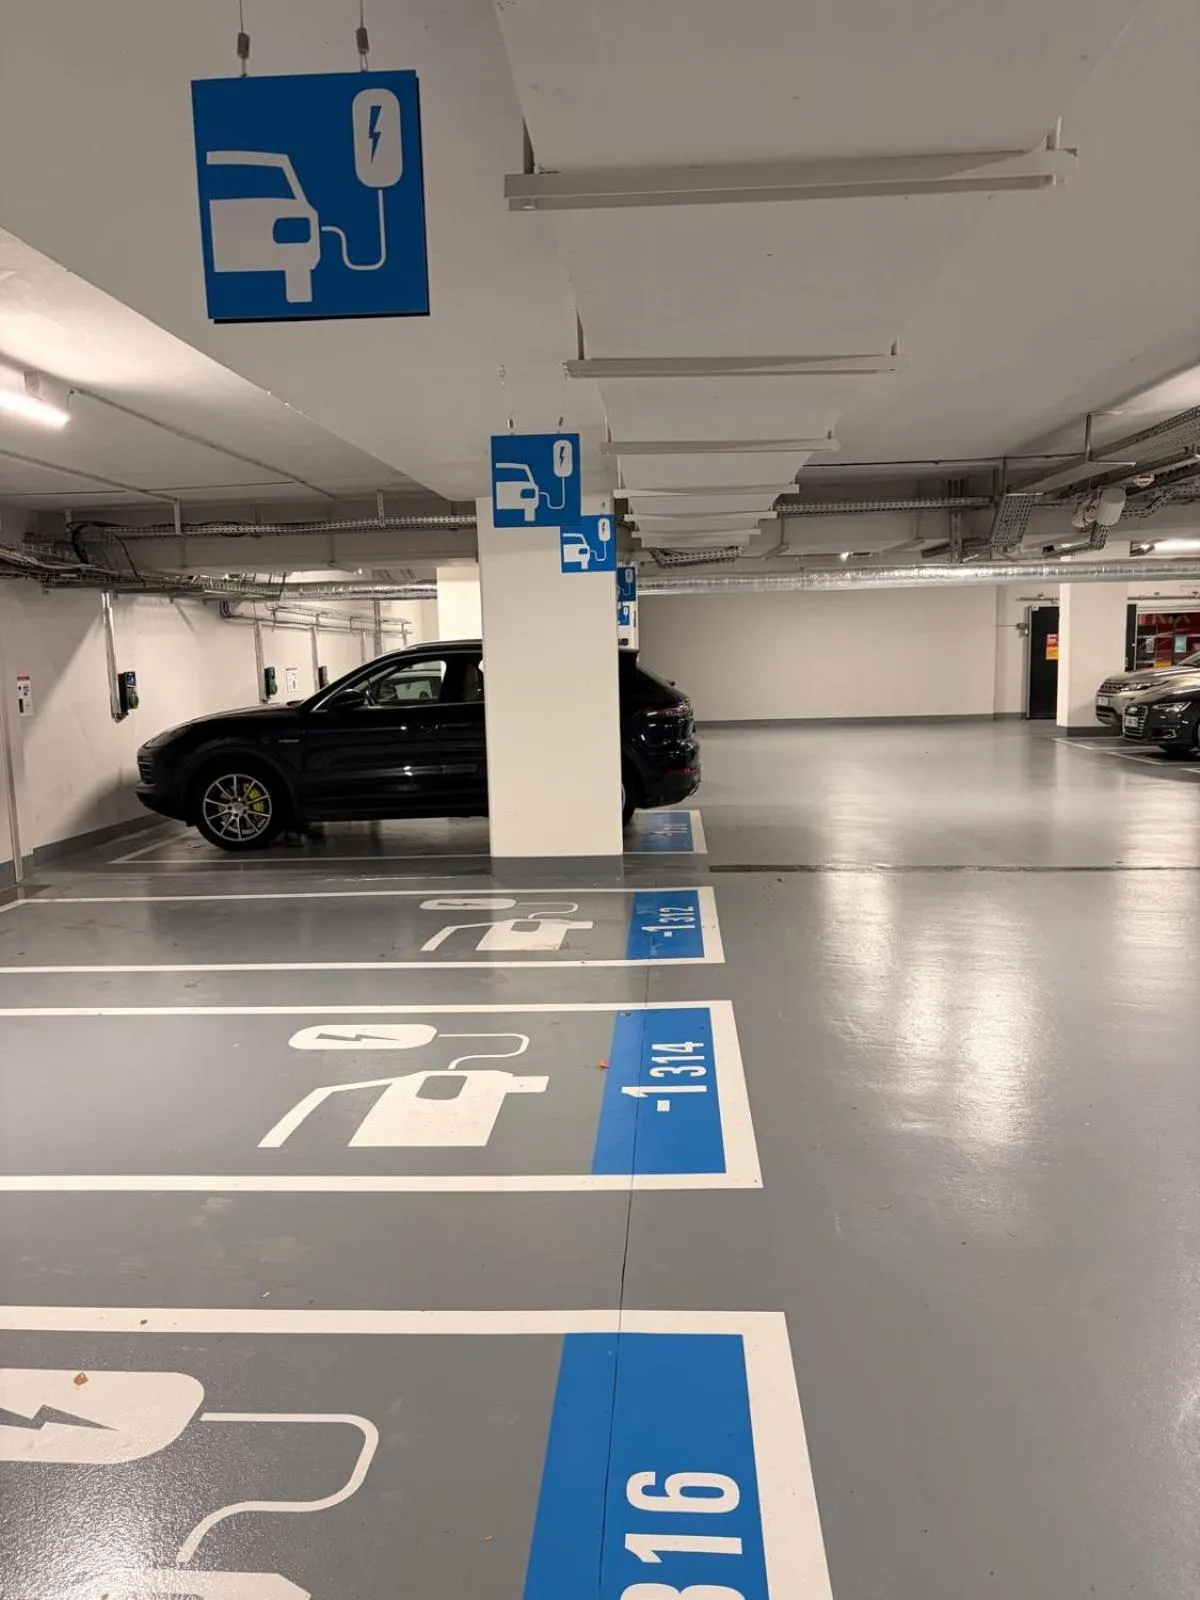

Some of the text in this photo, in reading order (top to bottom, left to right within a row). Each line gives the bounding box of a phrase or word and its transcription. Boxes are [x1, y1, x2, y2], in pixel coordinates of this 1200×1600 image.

[658, 906, 696, 923] 312
[621, 1041, 707, 1112] -1 314
